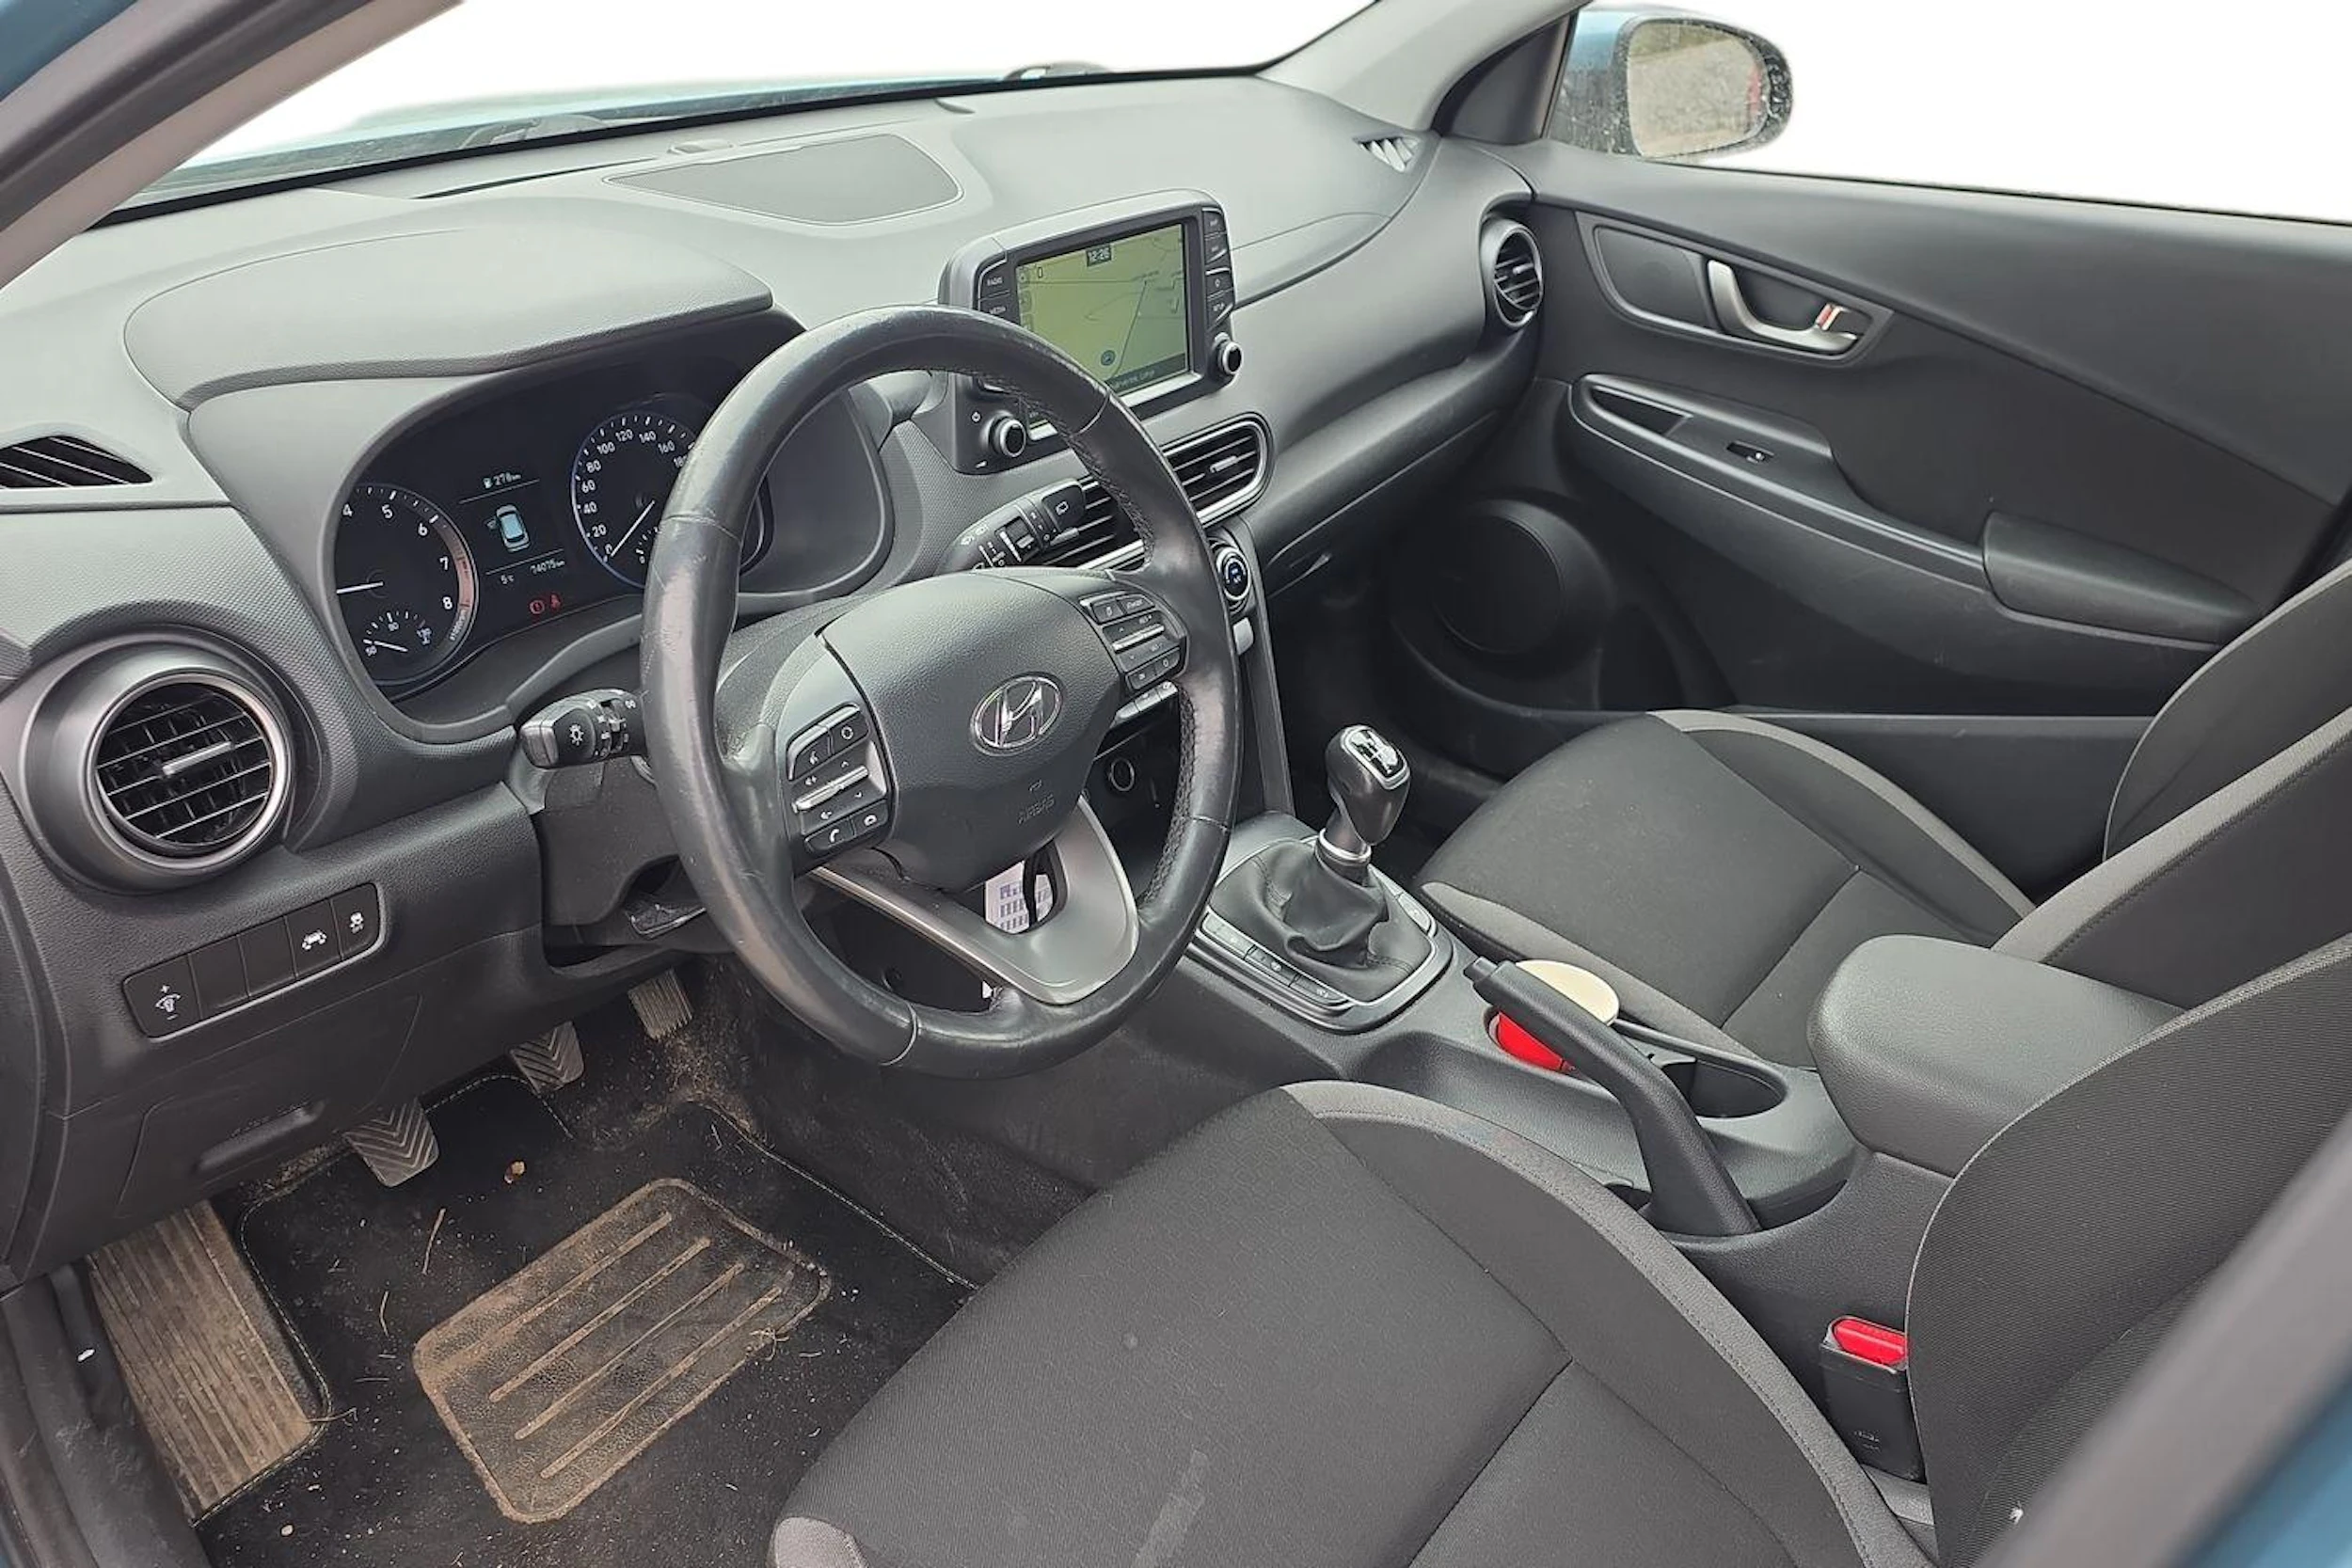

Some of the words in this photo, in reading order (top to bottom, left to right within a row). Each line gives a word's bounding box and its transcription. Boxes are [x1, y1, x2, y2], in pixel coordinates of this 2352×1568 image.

[615, 429, 633, 442] 120
[640, 431, 657, 443] 140
[596, 441, 616, 454] 100
[659, 440, 675, 453] 160
[586, 459, 602, 473] 80
[581, 479, 596, 493] 60
[342, 503, 353, 516] 4
[381, 504, 393, 518] 5
[583, 501, 597, 514] 40
[418, 523, 428, 536] 6
[592, 524, 607, 538] 20
[439, 556, 449, 570] 7
[442, 596, 453, 610] 8
